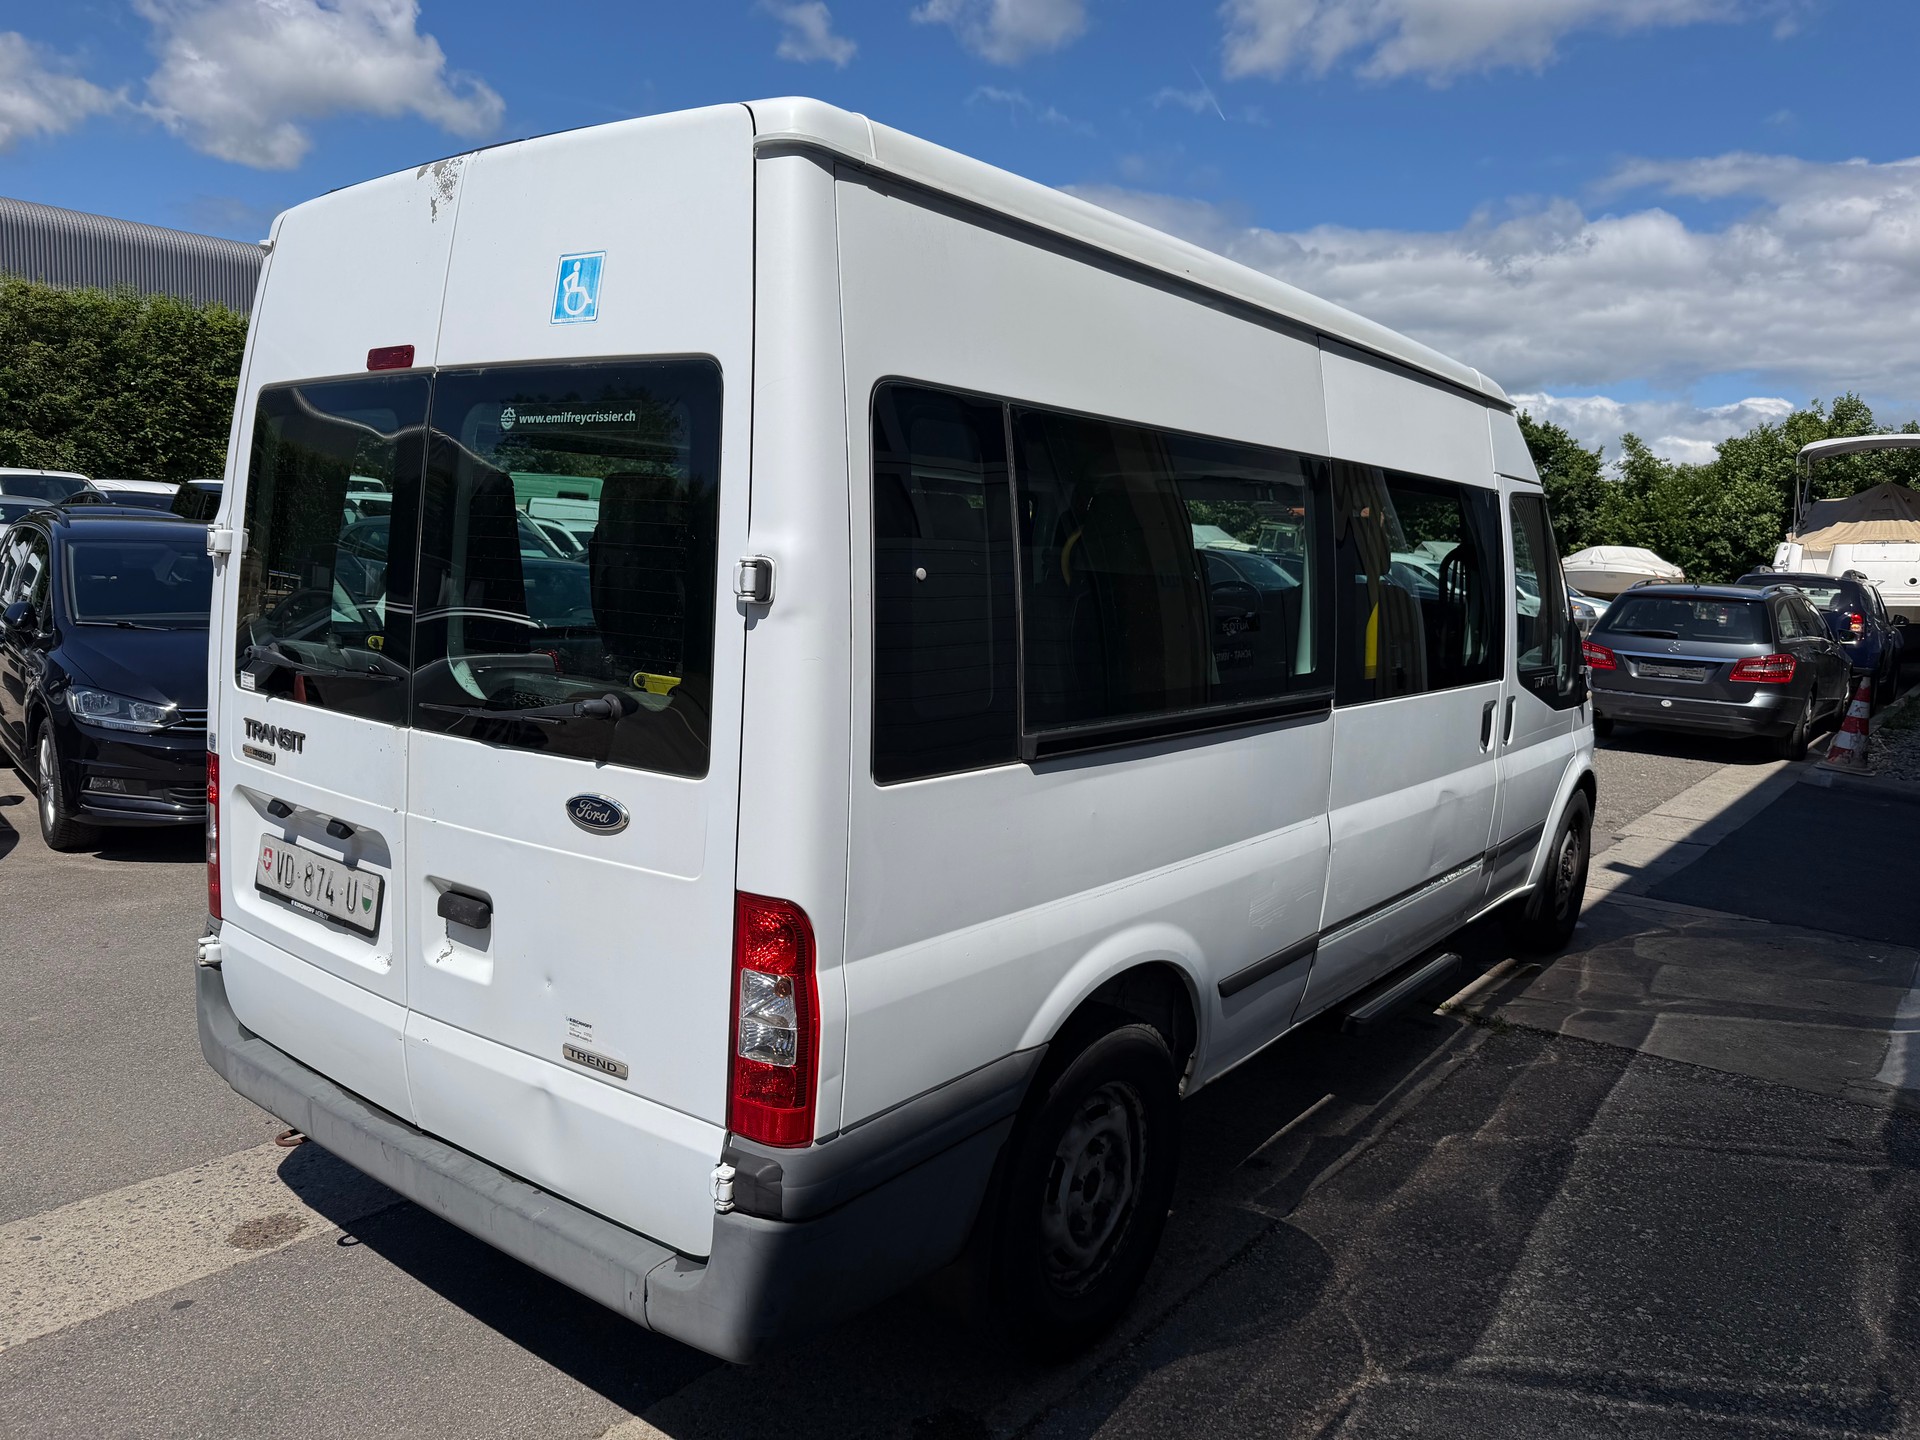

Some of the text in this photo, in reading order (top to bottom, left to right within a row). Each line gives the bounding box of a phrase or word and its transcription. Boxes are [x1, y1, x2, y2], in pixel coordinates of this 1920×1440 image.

[519, 410, 636, 425] www.emilfreycrissier.ch
[243, 717, 306, 755] TRANSIT
[576, 799, 611, 824] Ford
[568, 1048, 617, 1073] TREND
